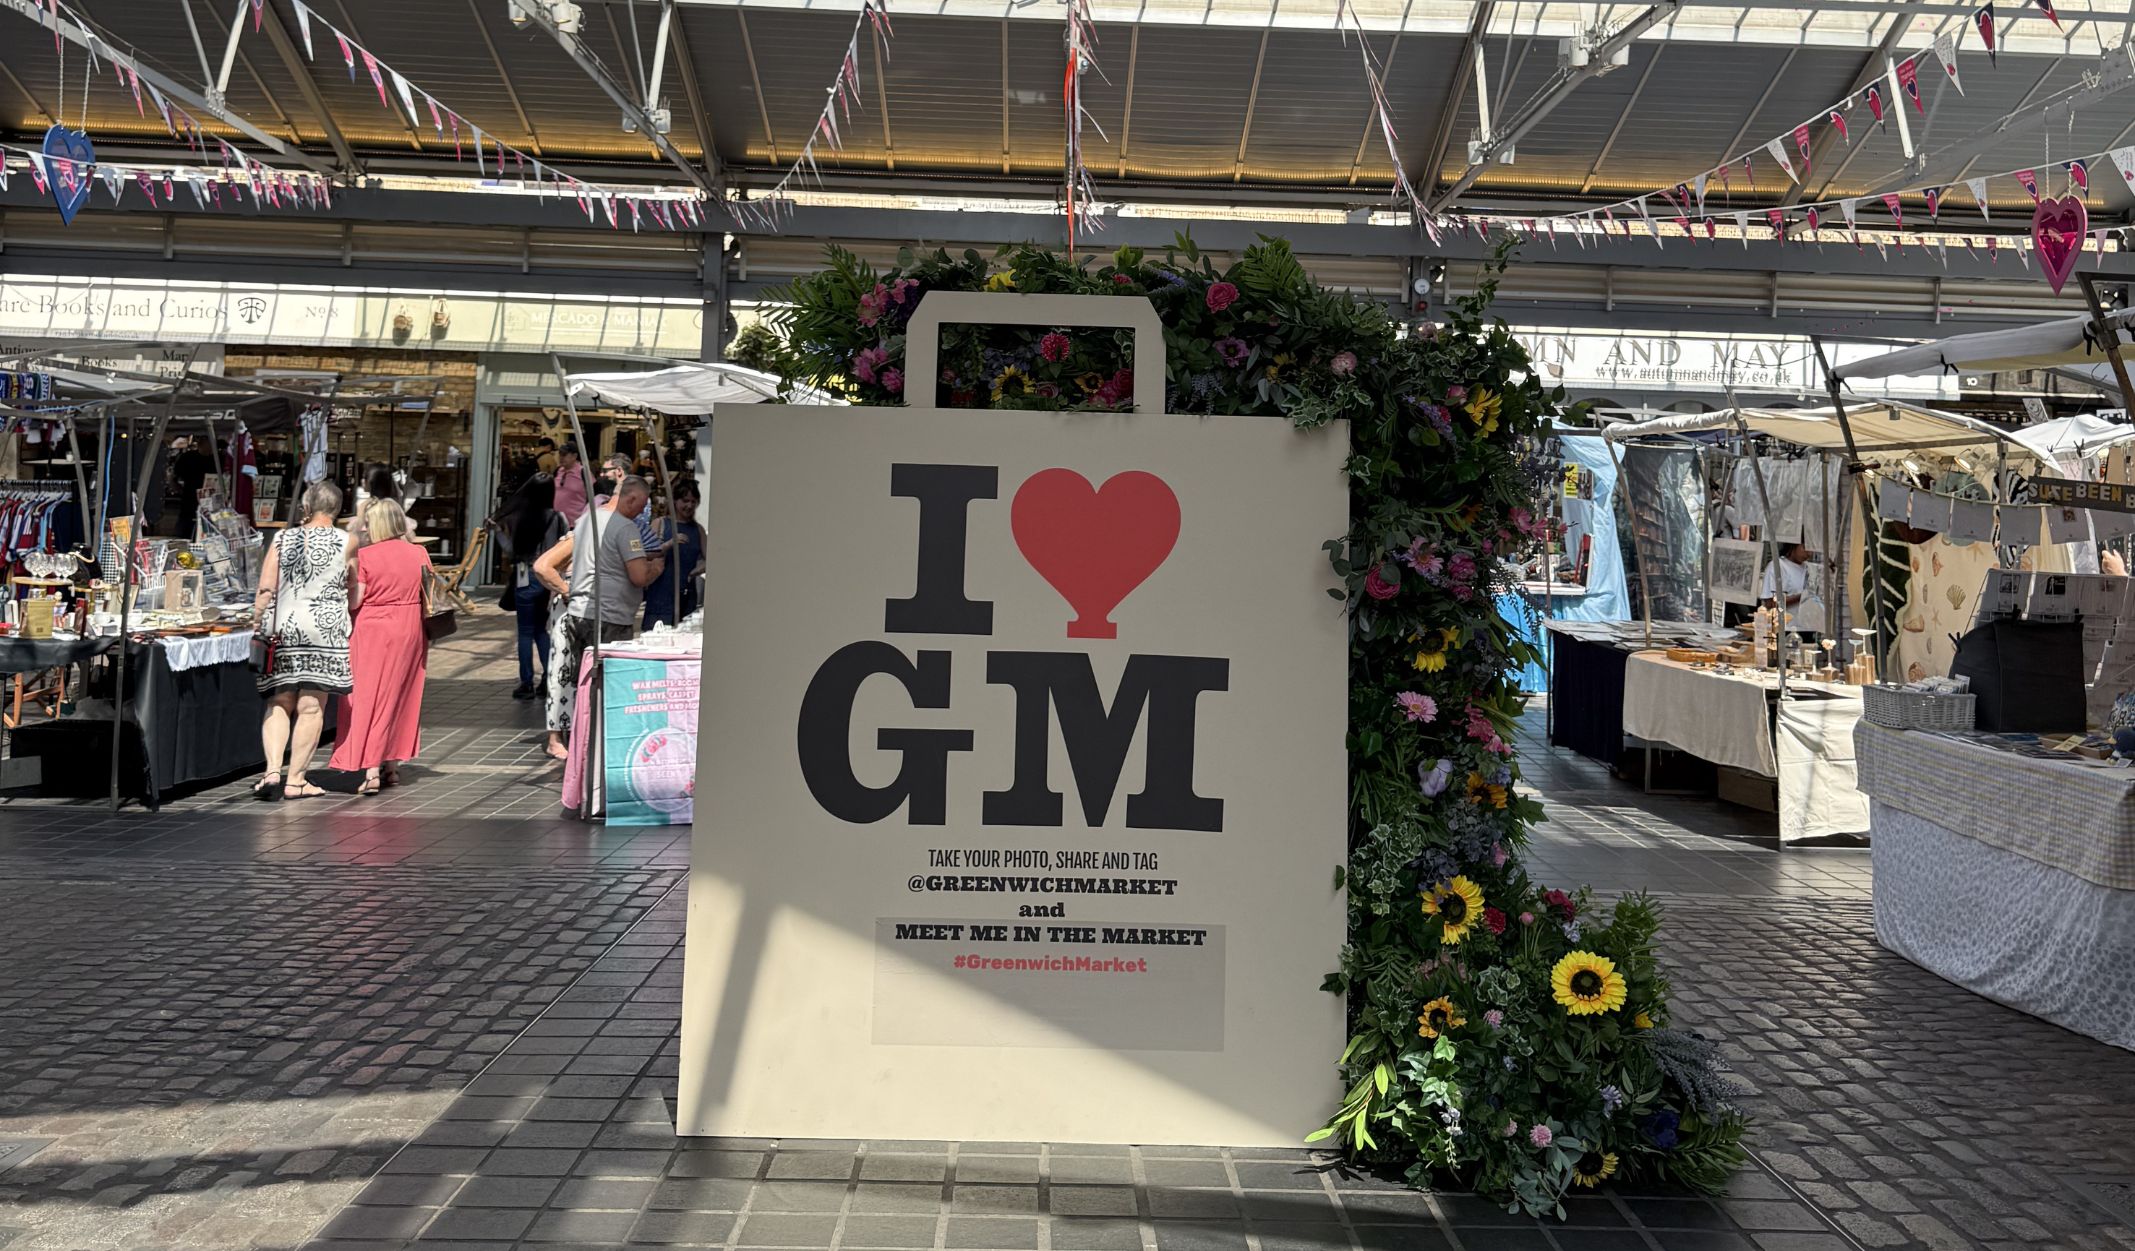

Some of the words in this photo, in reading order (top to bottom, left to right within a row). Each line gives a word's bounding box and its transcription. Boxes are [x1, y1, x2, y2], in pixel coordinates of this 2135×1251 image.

[40, 295, 105, 316] Books
[112, 300, 150, 318] and
[160, 299, 228, 321] Curios
[81, 355, 118, 368] Books
[1603, 339, 1681, 366] AND
[1712, 342, 1790, 368] MAY
[2075, 483, 2122, 502] BEEN
[885, 463, 998, 635] I
[797, 641, 1229, 832] GM
[928, 849, 960, 867] TAKE
[964, 850, 1000, 867] YOUR
[1004, 850, 1052, 871] PHOTO,
[1055, 851, 1099, 869] SHARE
[1102, 852, 1129, 869] AND
[1132, 853, 1158, 870] TAG
[908, 875, 1178, 895] @GREENWICHMARKET
[1018, 902, 1066, 918] and
[895, 924, 964, 941] MEET
[969, 925, 1008, 942] ME
[1013, 926, 1041, 942] IN
[1047, 927, 1096, 944] THE
[1101, 928, 1207, 946] MARKET
[953, 954, 1147, 972] #GreenwichMarket
